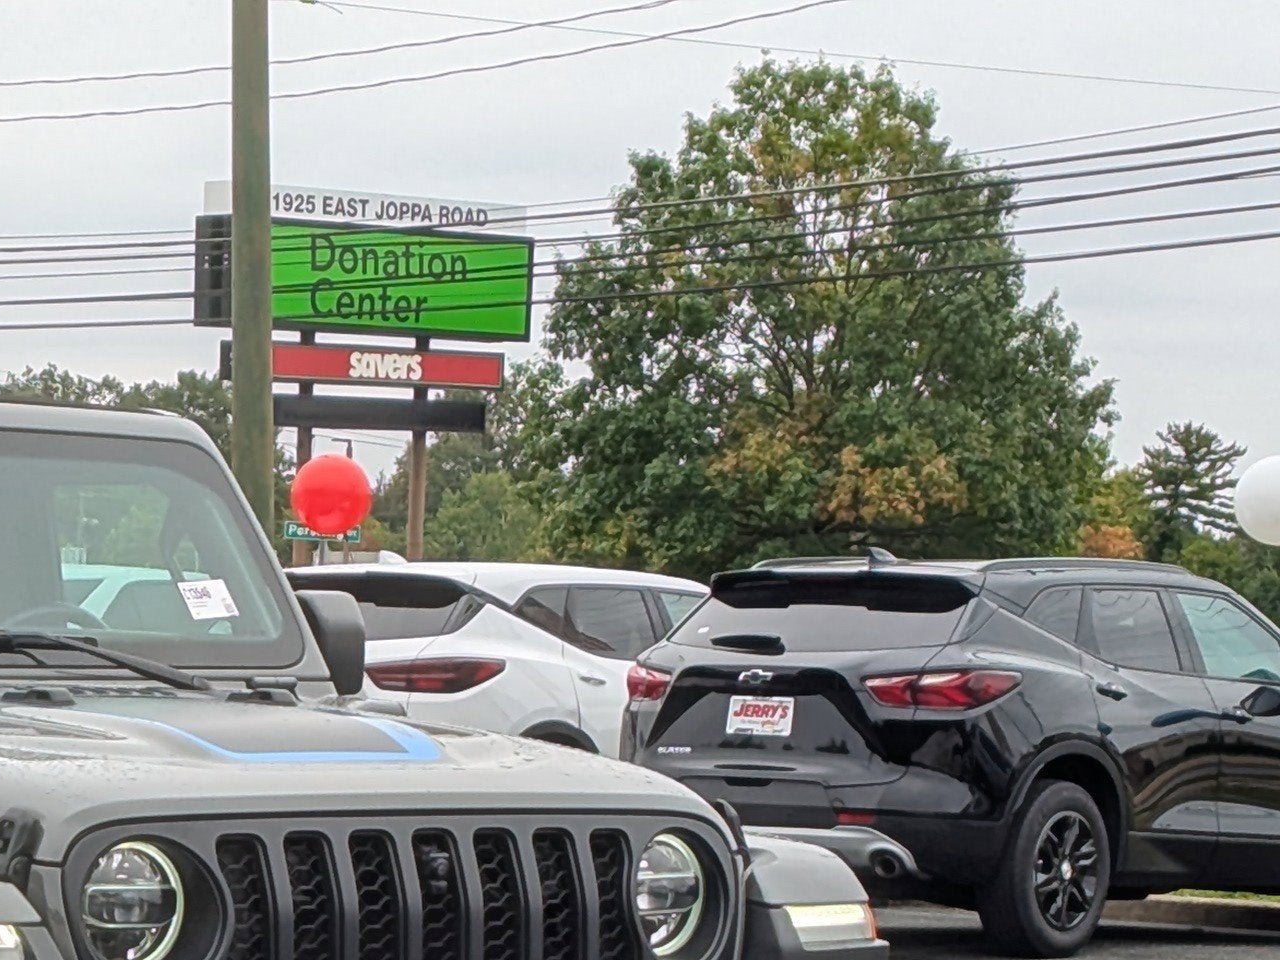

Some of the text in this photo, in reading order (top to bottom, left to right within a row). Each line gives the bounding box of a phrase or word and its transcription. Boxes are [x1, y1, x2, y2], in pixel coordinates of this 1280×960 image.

[272, 192, 489, 226] 1925 EAST JOPPA ROAD
[310, 234, 468, 282] Donation
[310, 277, 428, 323] Center
[349, 351, 422, 380] savers
[733, 703, 790, 720] JERRY'S
